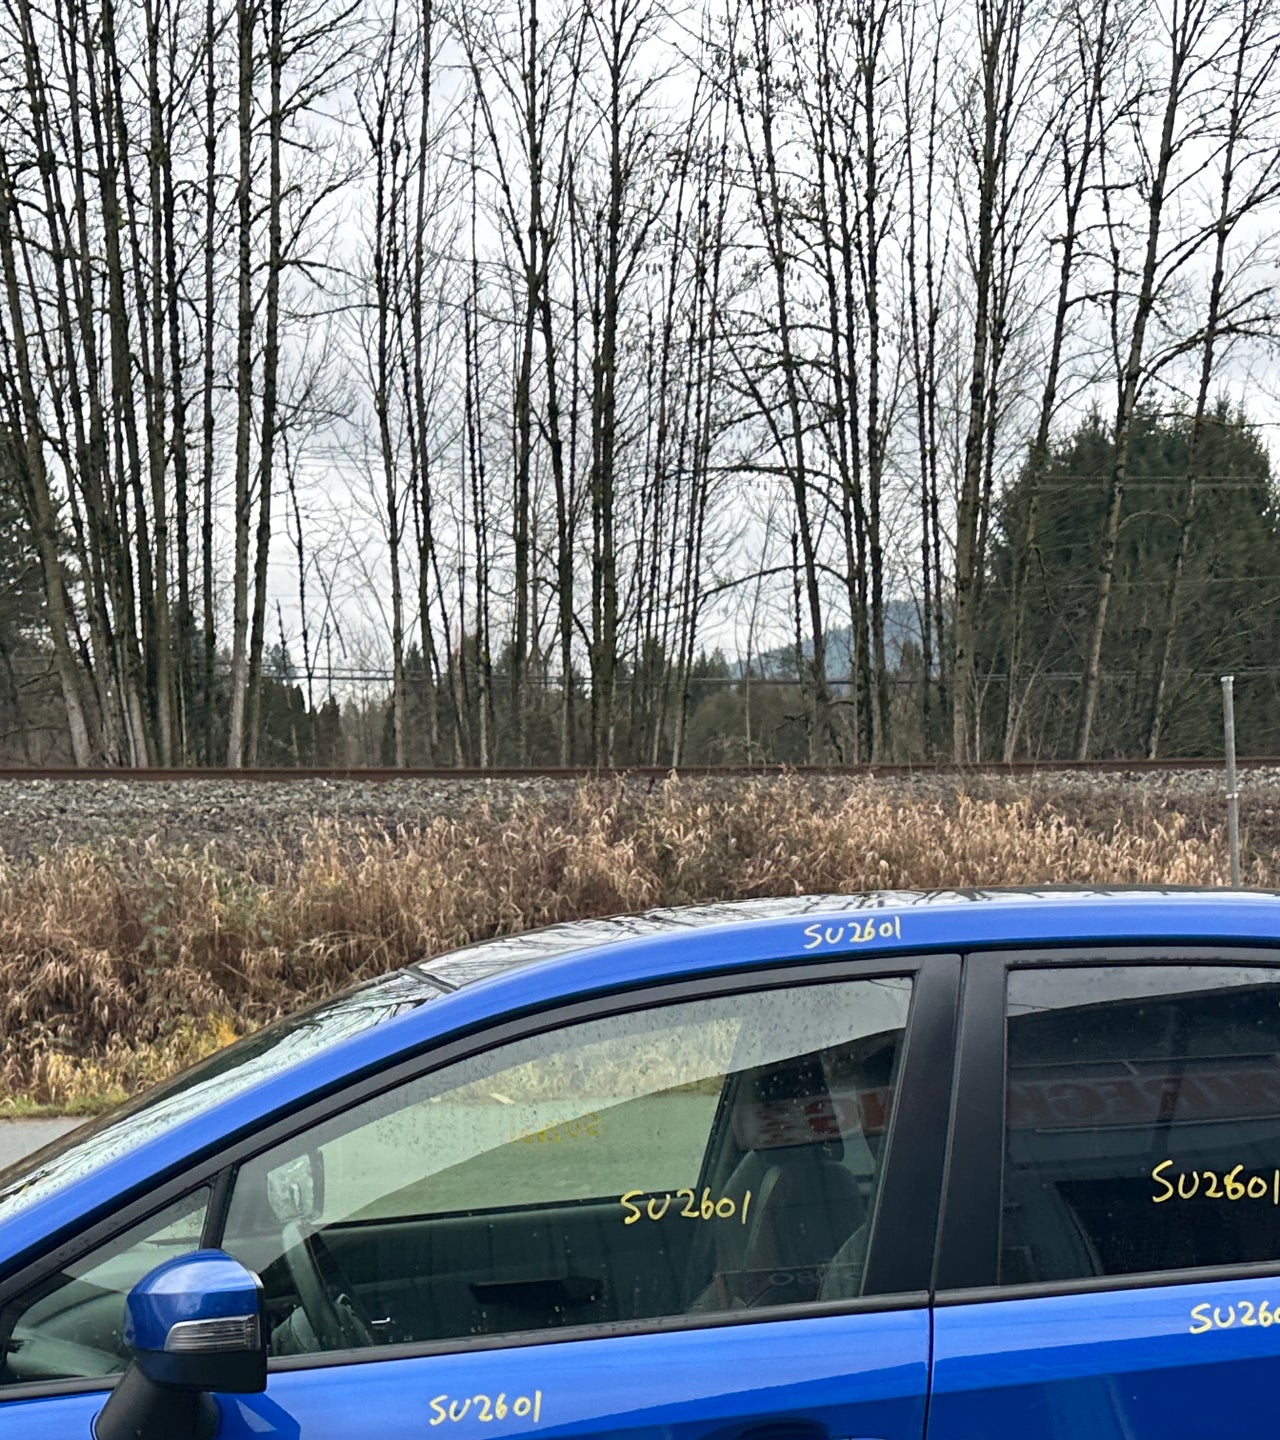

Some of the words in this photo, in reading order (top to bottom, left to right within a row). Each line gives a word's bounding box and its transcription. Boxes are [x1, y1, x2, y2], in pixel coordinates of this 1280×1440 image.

[803, 915, 902, 950] SU2601
[1150, 1159, 1280, 1205] SU2601
[620, 1188, 753, 1225] SU2601
[427, 1389, 544, 1427] SU2601
